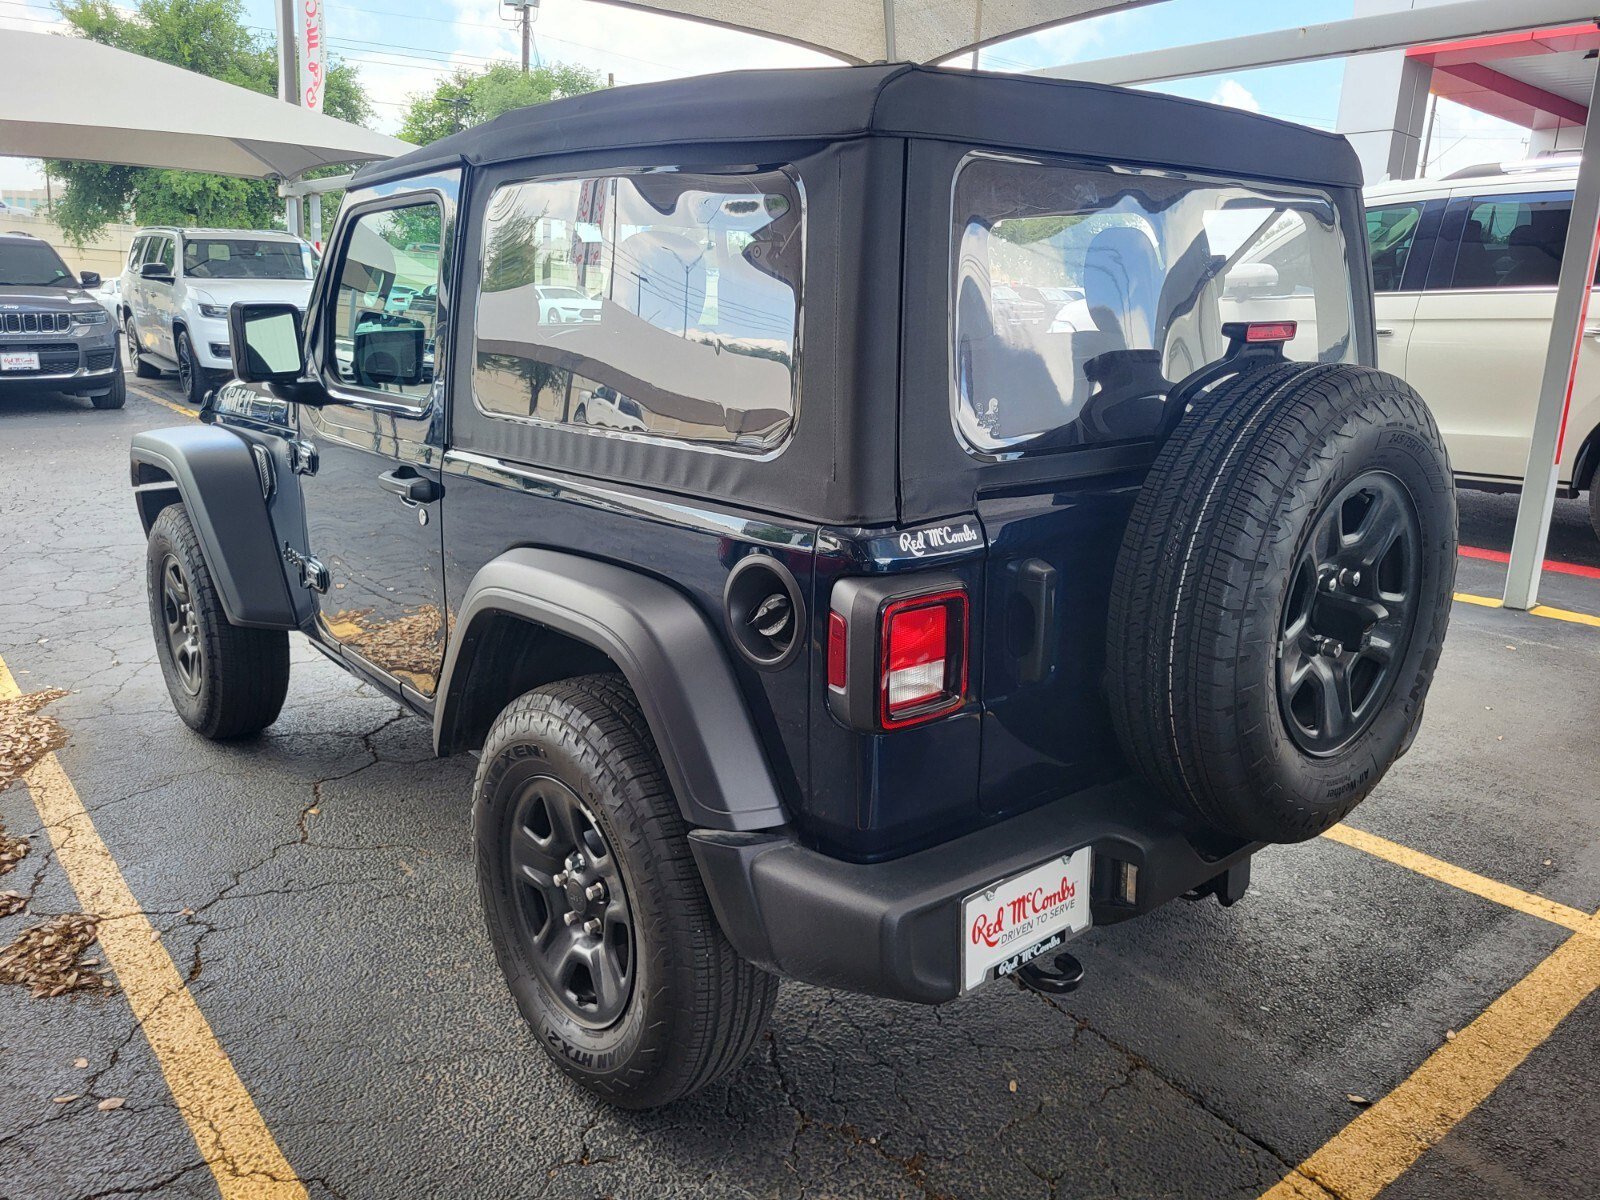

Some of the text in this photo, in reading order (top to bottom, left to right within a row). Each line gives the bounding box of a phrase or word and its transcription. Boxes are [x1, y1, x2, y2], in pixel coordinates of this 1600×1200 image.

[900, 524, 977, 557] Red McCombs
[972, 876, 1076, 948] Red McCombs
[1001, 898, 1076, 945] DRIVEN TO SERVE
[999, 935, 1061, 976] Red McCombs
